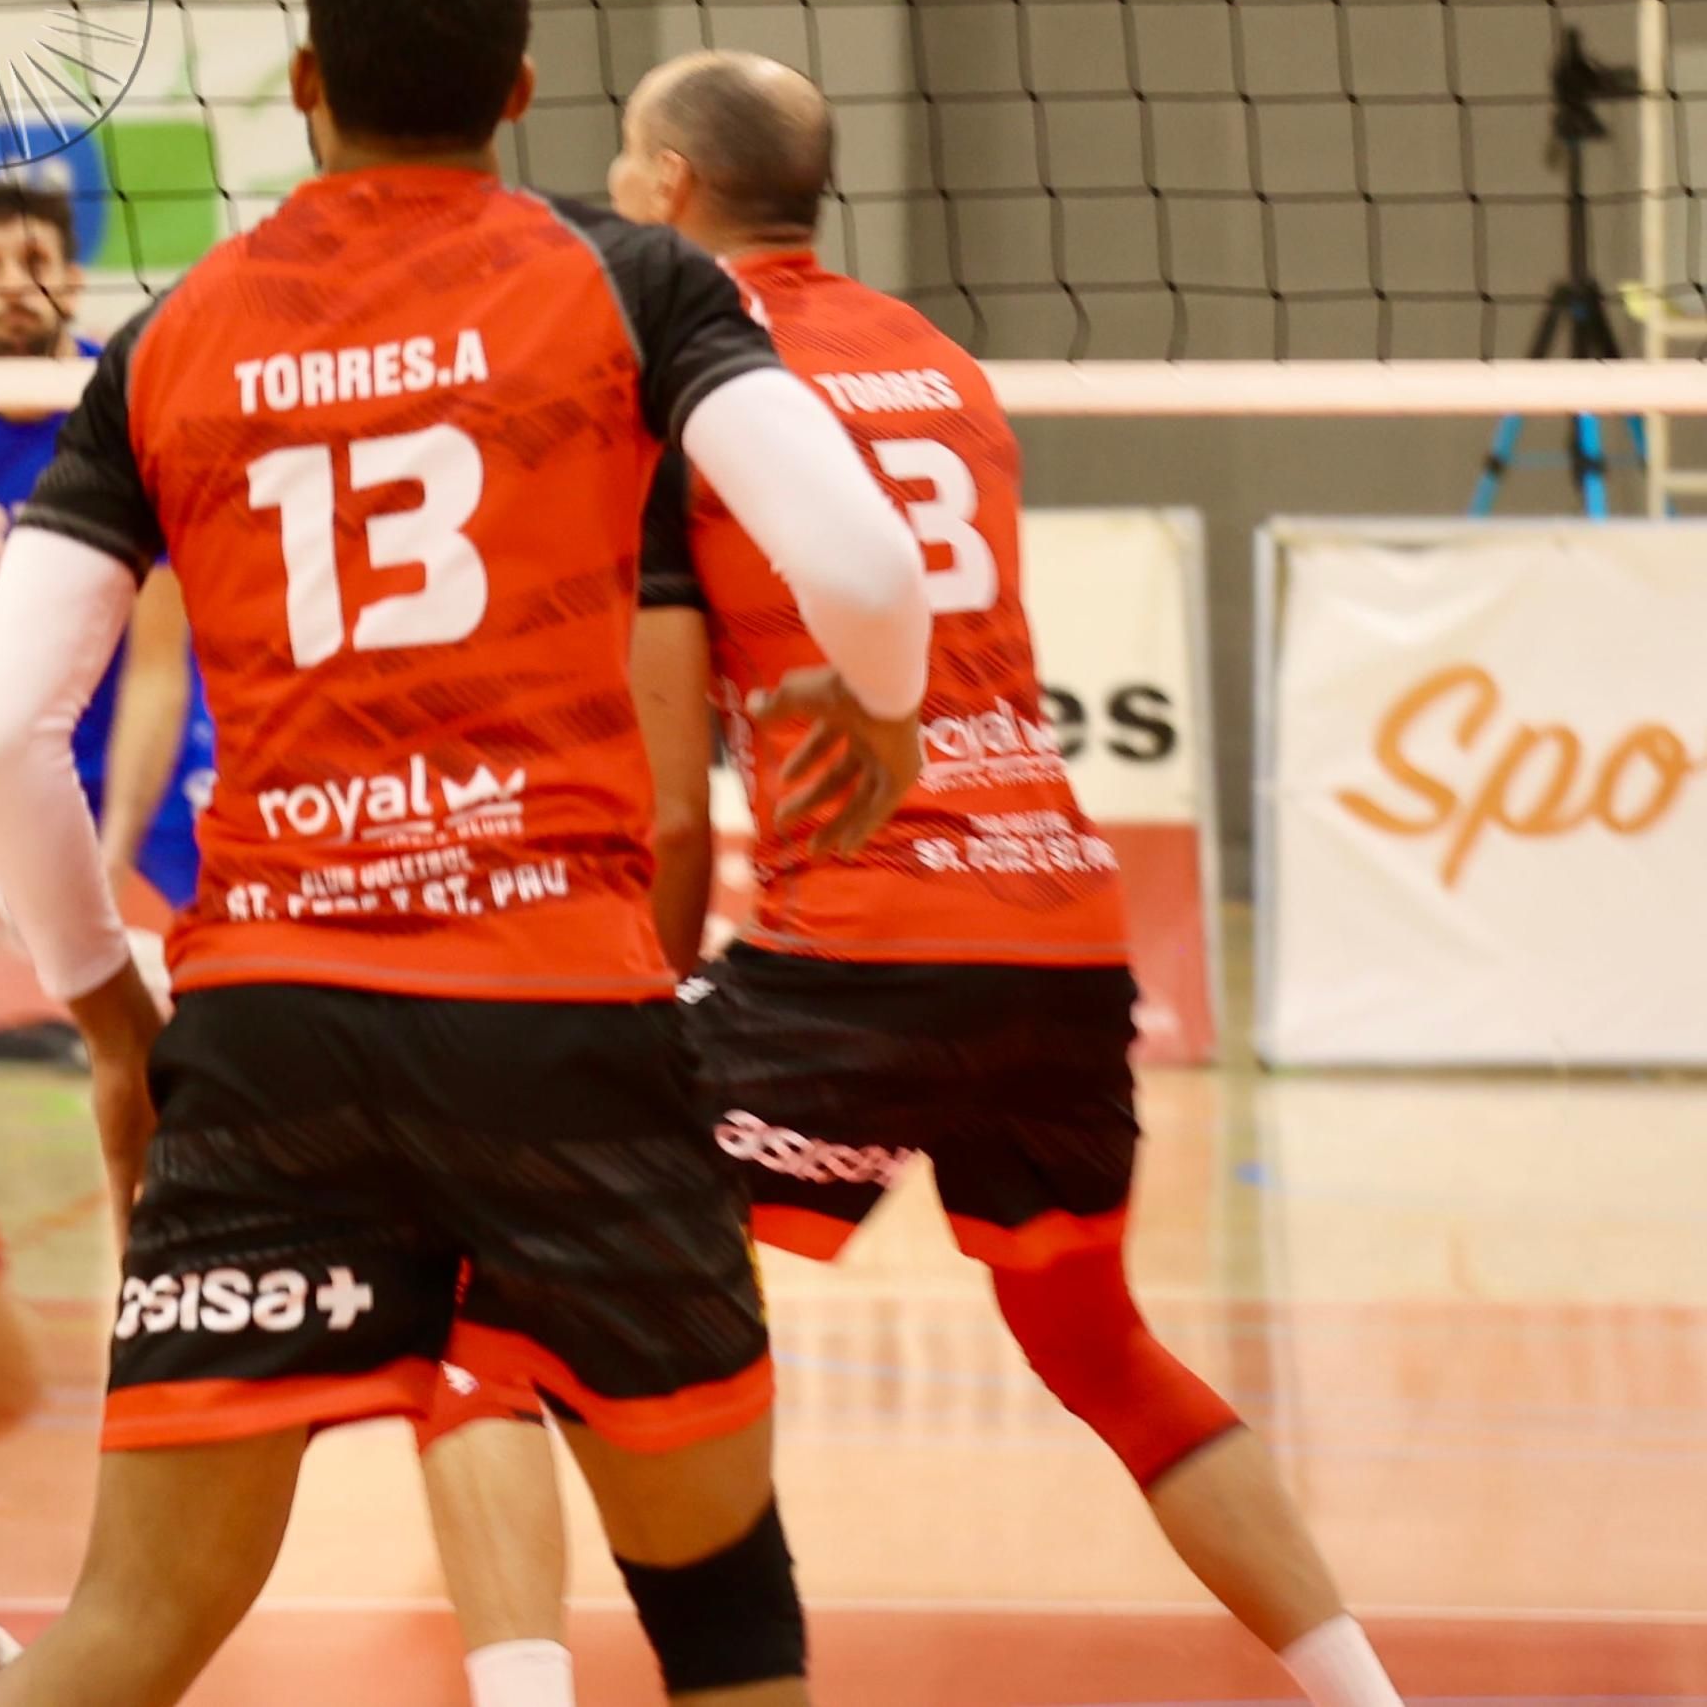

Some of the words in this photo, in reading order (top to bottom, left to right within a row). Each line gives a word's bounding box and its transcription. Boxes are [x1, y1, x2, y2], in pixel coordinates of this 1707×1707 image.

[234, 329, 489, 416] TORRES.A
[245, 422, 489, 669] 13
[257, 753, 434, 844] royal
